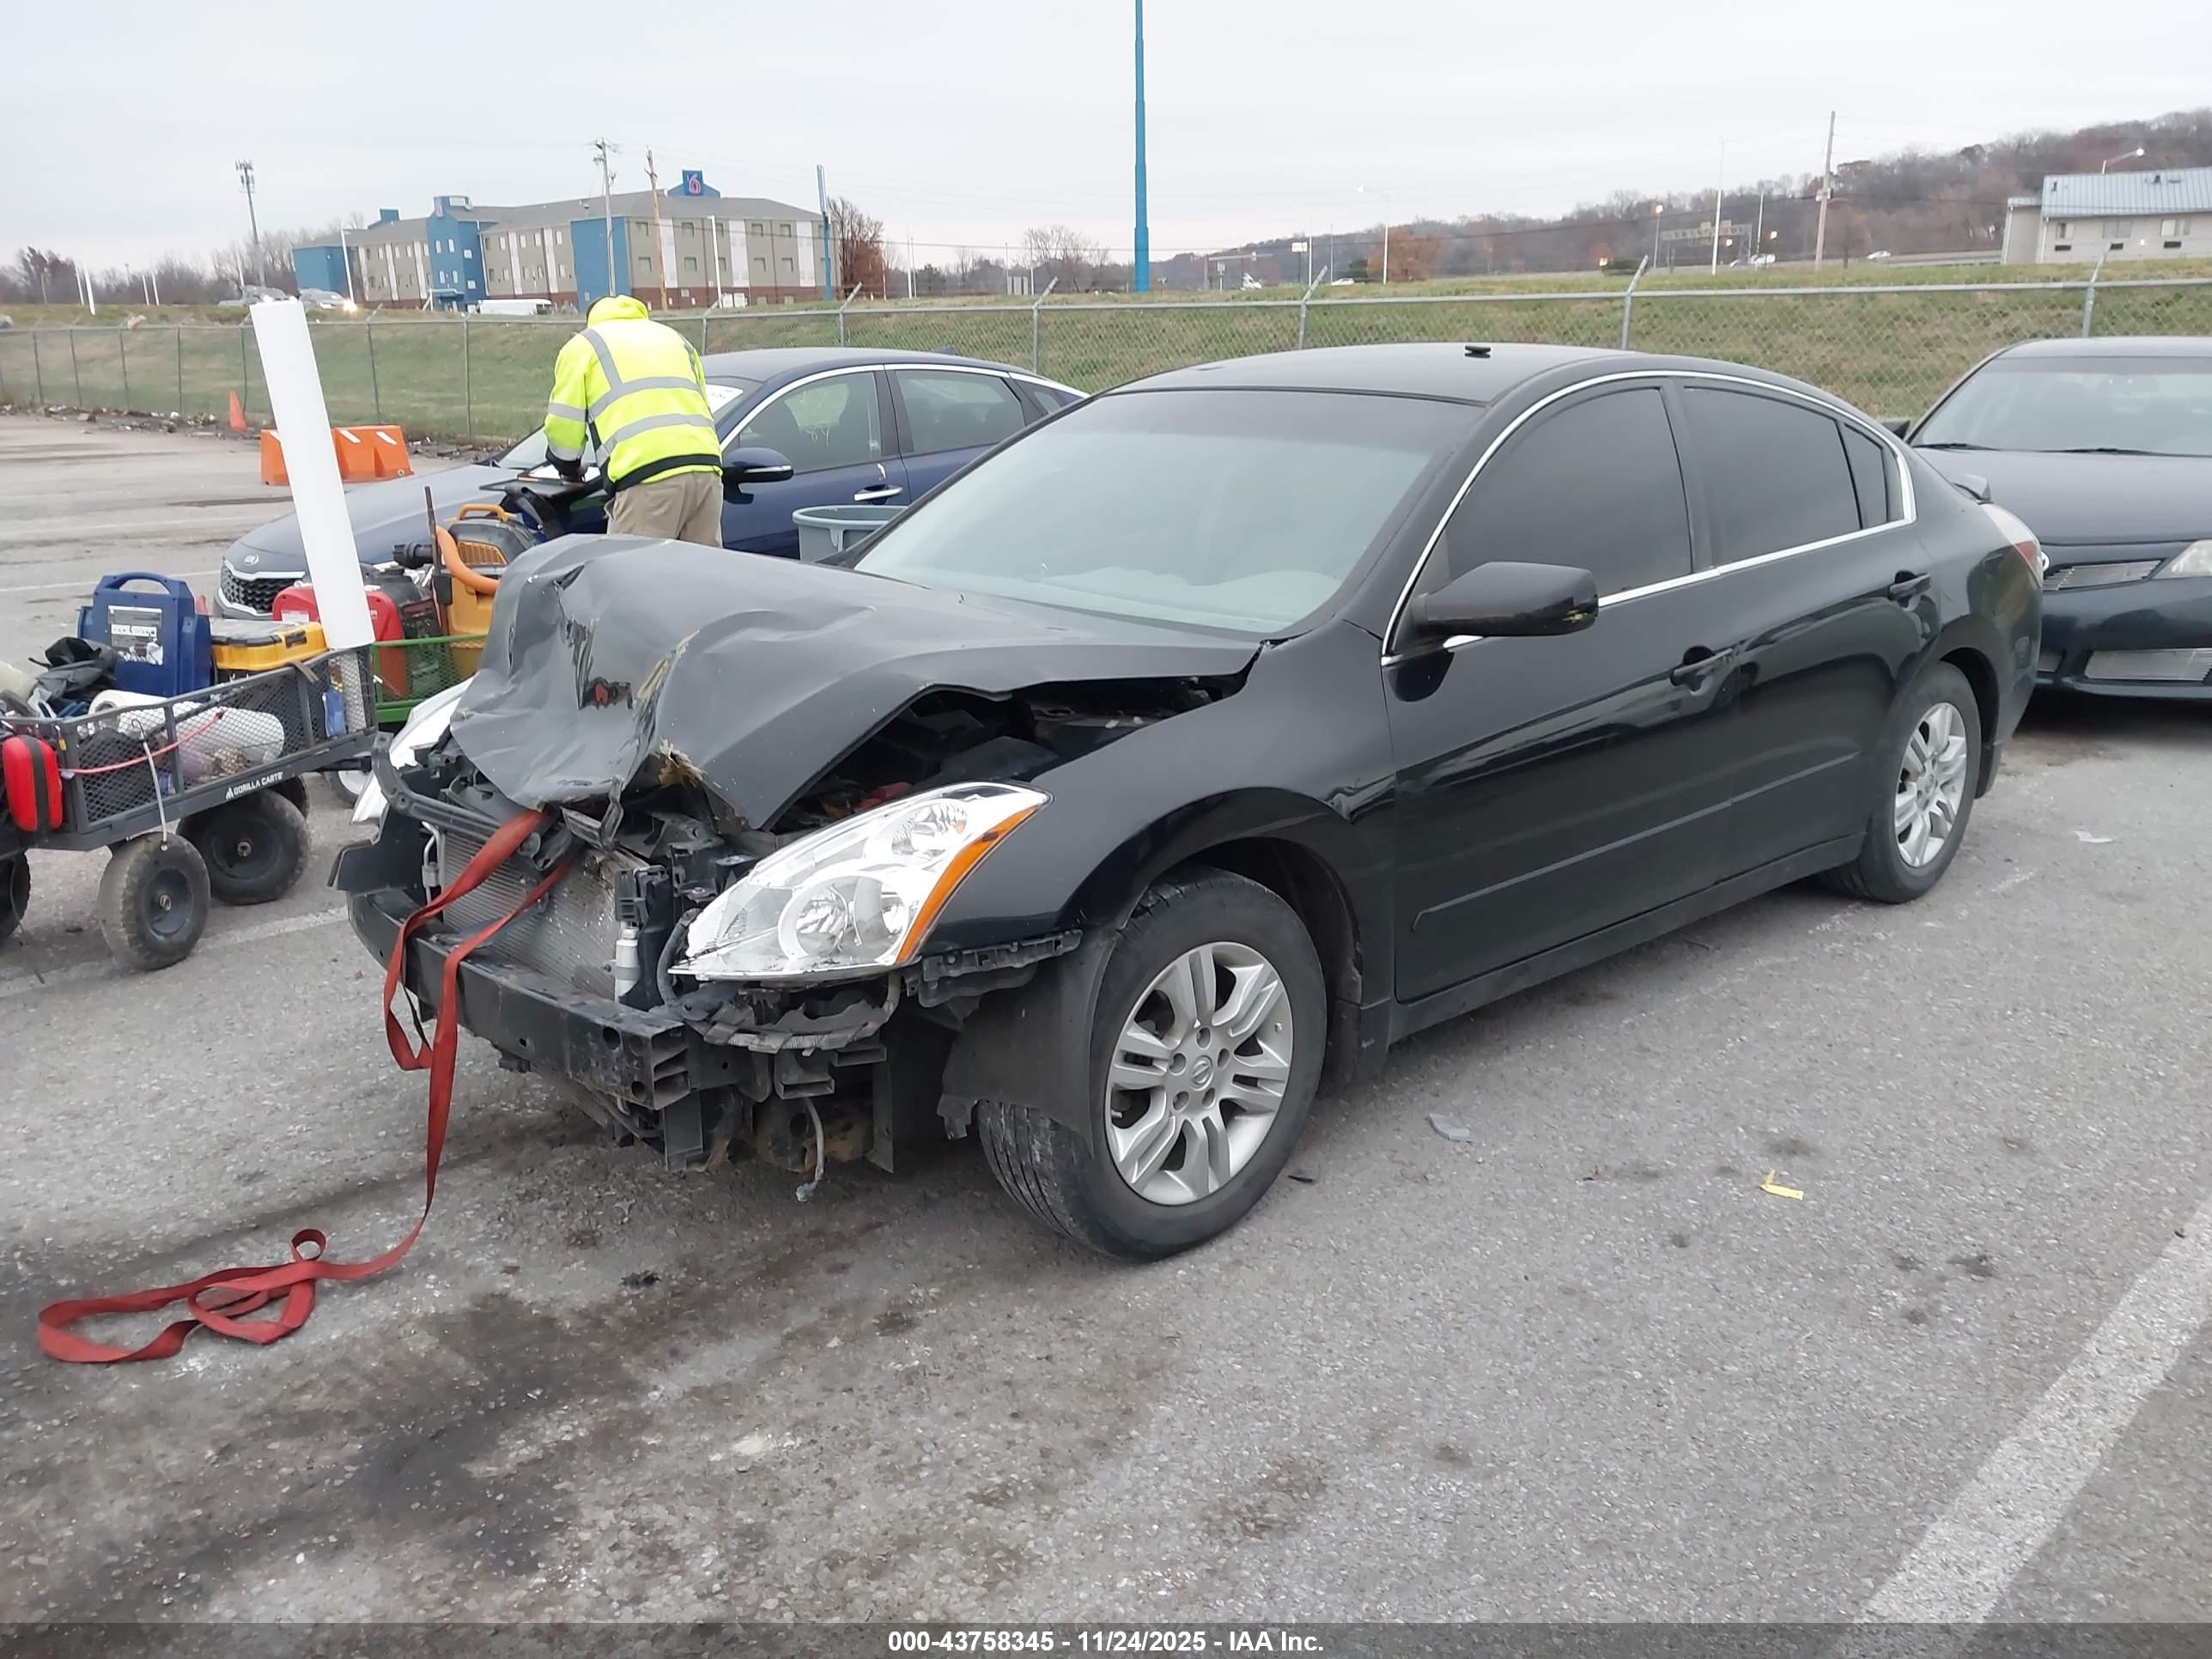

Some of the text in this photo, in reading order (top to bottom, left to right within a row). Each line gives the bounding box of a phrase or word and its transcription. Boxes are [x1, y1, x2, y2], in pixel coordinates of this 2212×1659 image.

[689, 173, 701, 194] 6
[233, 771, 283, 795] GORILLA CARTS
